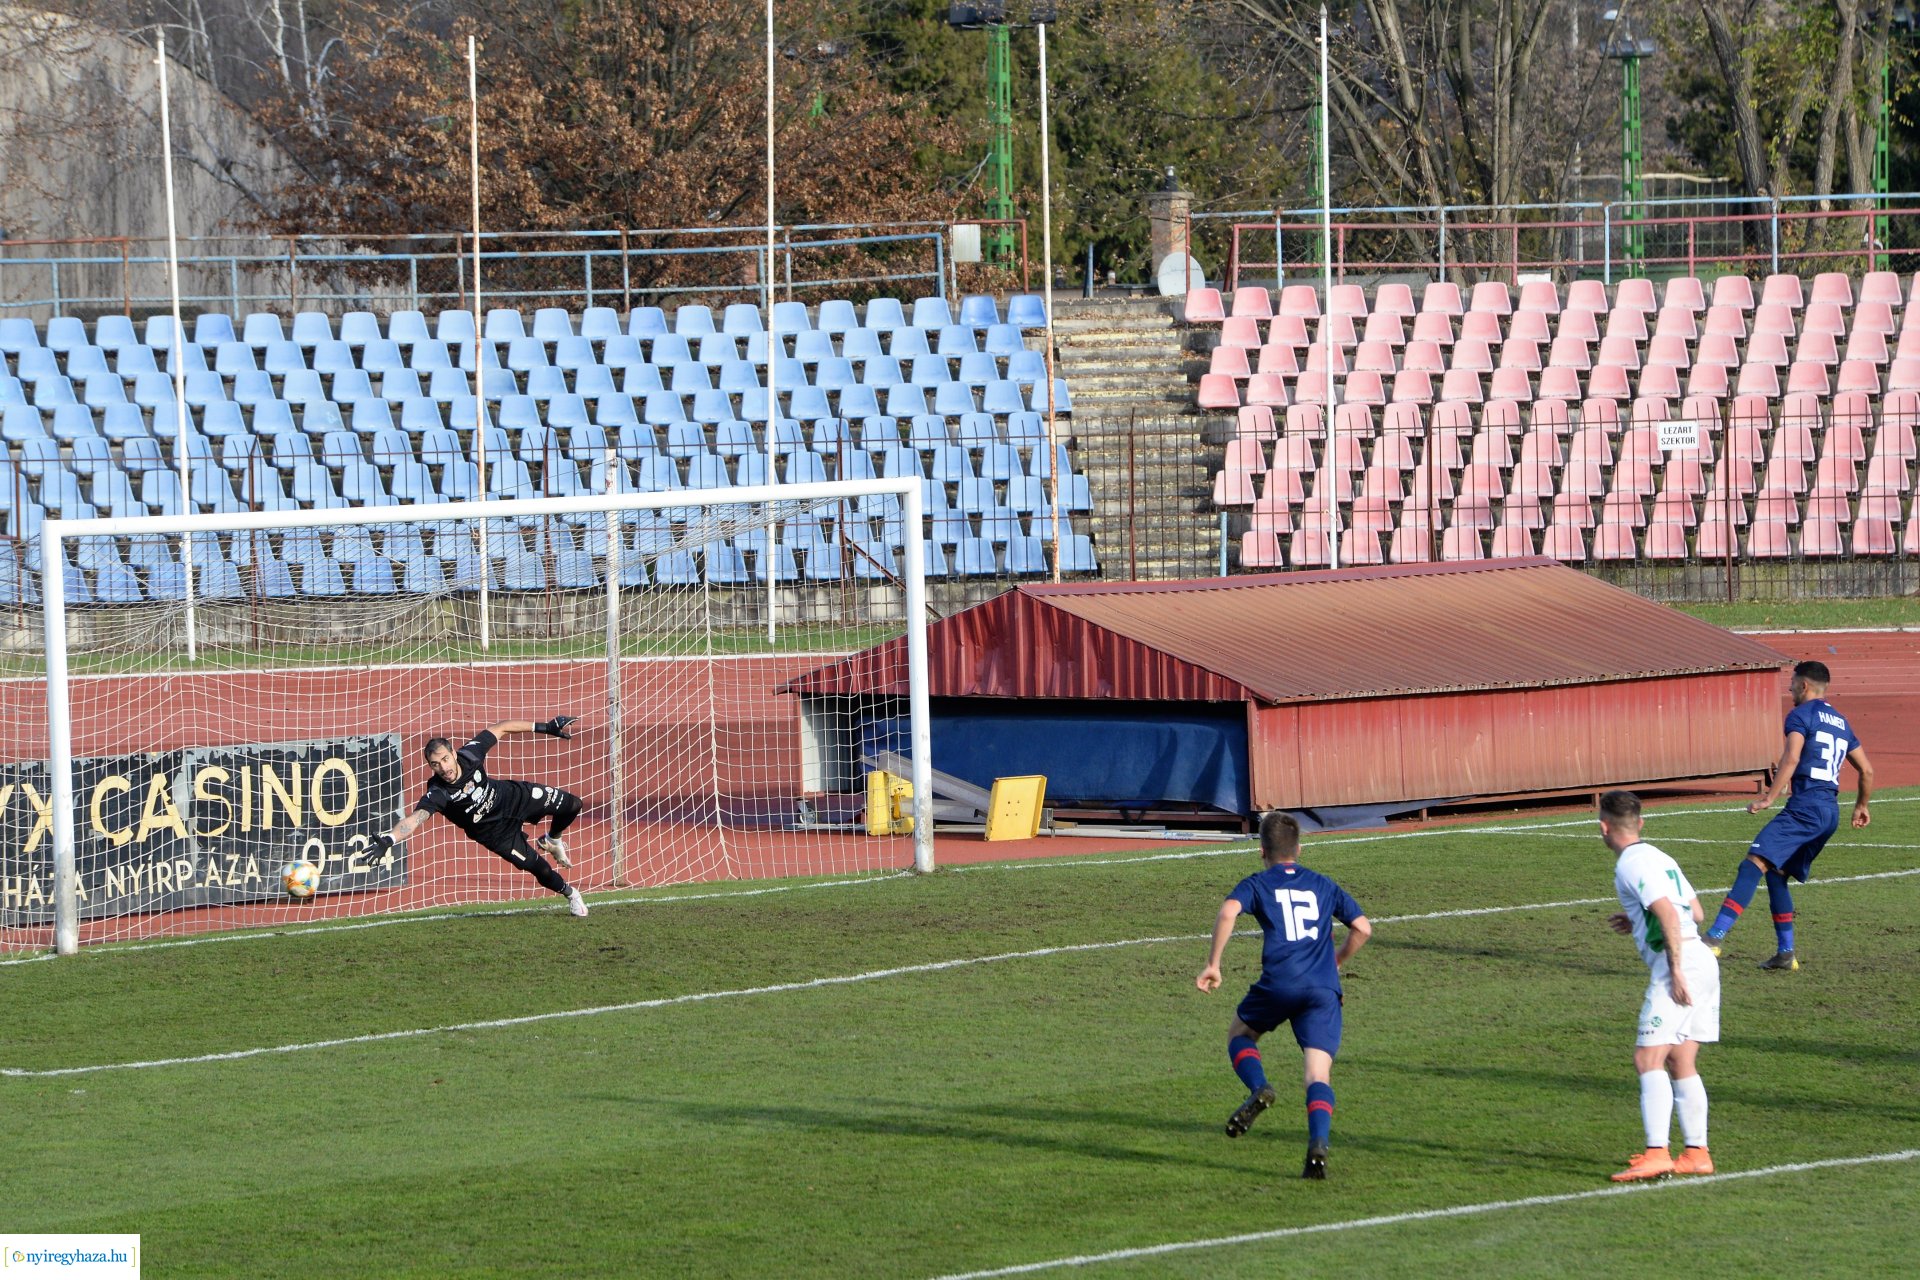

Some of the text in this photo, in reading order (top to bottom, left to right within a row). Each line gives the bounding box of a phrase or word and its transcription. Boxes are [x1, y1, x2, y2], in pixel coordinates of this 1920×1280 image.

[1661, 436, 1696, 446] SZEKTOR
[1810, 730, 1849, 785] 30
[90, 757, 358, 846] CASINO
[1275, 888, 1320, 942] 12
